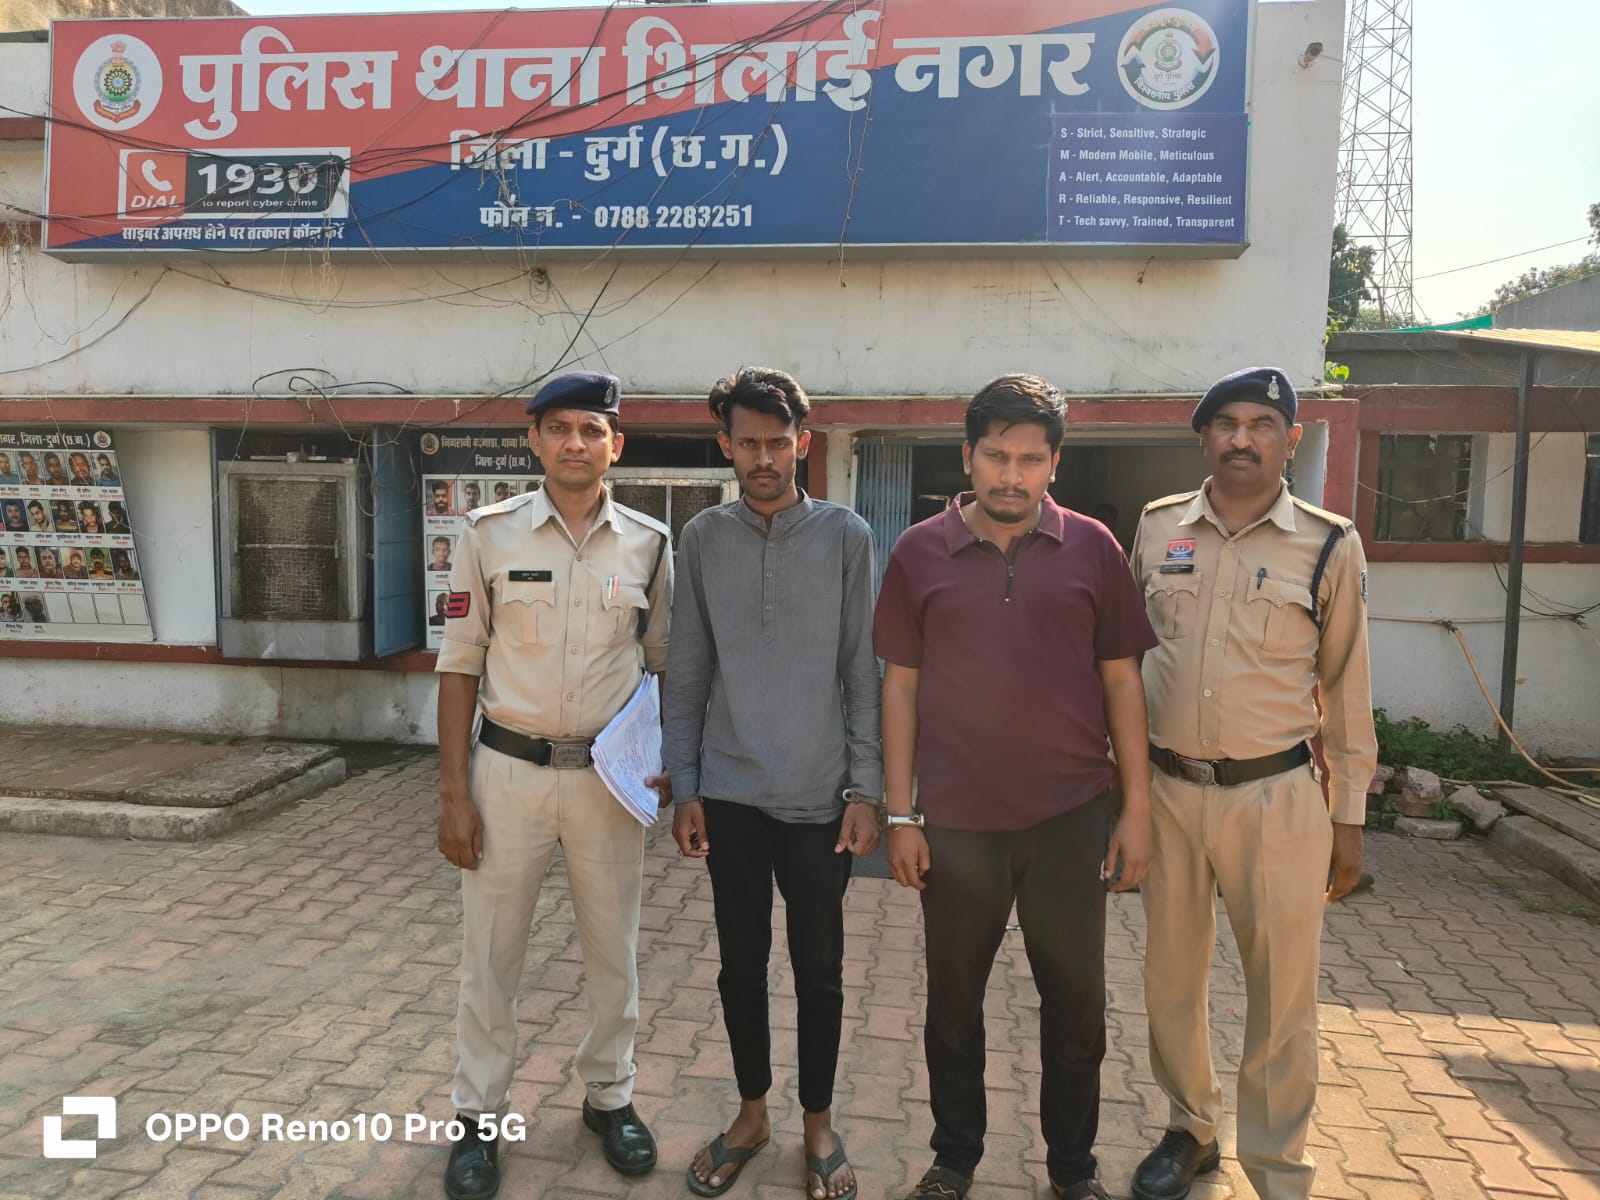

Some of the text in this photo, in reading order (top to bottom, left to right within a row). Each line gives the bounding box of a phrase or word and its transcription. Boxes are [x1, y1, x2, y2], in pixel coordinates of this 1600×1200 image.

[179, 10, 1095, 140] पुलिस थाना भिलाई नगर
[1060, 127, 1068, 139] S
[1077, 127, 1106, 139] Strict,
[1109, 127, 1158, 140] Sensitive,
[1161, 127, 1207, 141] Strategic
[449, 129, 551, 170] जिला
[584, 125, 644, 181] दुर्ग
[651, 123, 788, 177] (छ.ग.)
[1060, 149, 1070, 160] M
[1079, 149, 1116, 160] Modern
[1119, 149, 1157, 162] Mobile,
[1160, 150, 1215, 161] Meticulous
[197, 162, 318, 195] 1930
[1059, 171, 1066, 182] A
[1076, 171, 1103, 183] Alert,
[1105, 171, 1169, 184] Accountable,
[1172, 172, 1223, 185] Adaptable
[216, 199, 250, 209] report
[252, 200, 283, 209] cyber
[287, 199, 318, 208] crime
[1059, 193, 1066, 204] R
[1076, 193, 1121, 206] Reliable,
[1123, 193, 1184, 207] Responsive,
[1187, 194, 1232, 205] Resilient
[480, 201, 531, 228] फोन
[594, 205, 649, 229] 0788
[655, 204, 753, 228] 2283251
[1058, 215, 1065, 226] T
[1074, 215, 1096, 226] Tech
[1098, 217, 1129, 229] savvy,
[1132, 216, 1173, 228] Trained,
[1176, 216, 1235, 229] Transparent
[121, 226, 161, 242] साइबर
[161, 226, 203, 240] अपराध
[204, 223, 227, 240] होने
[230, 226, 246, 240] पर
[247, 226, 291, 240] तत्काल
[293, 223, 322, 241] कॉल
[0, 433, 20, 446] गर,
